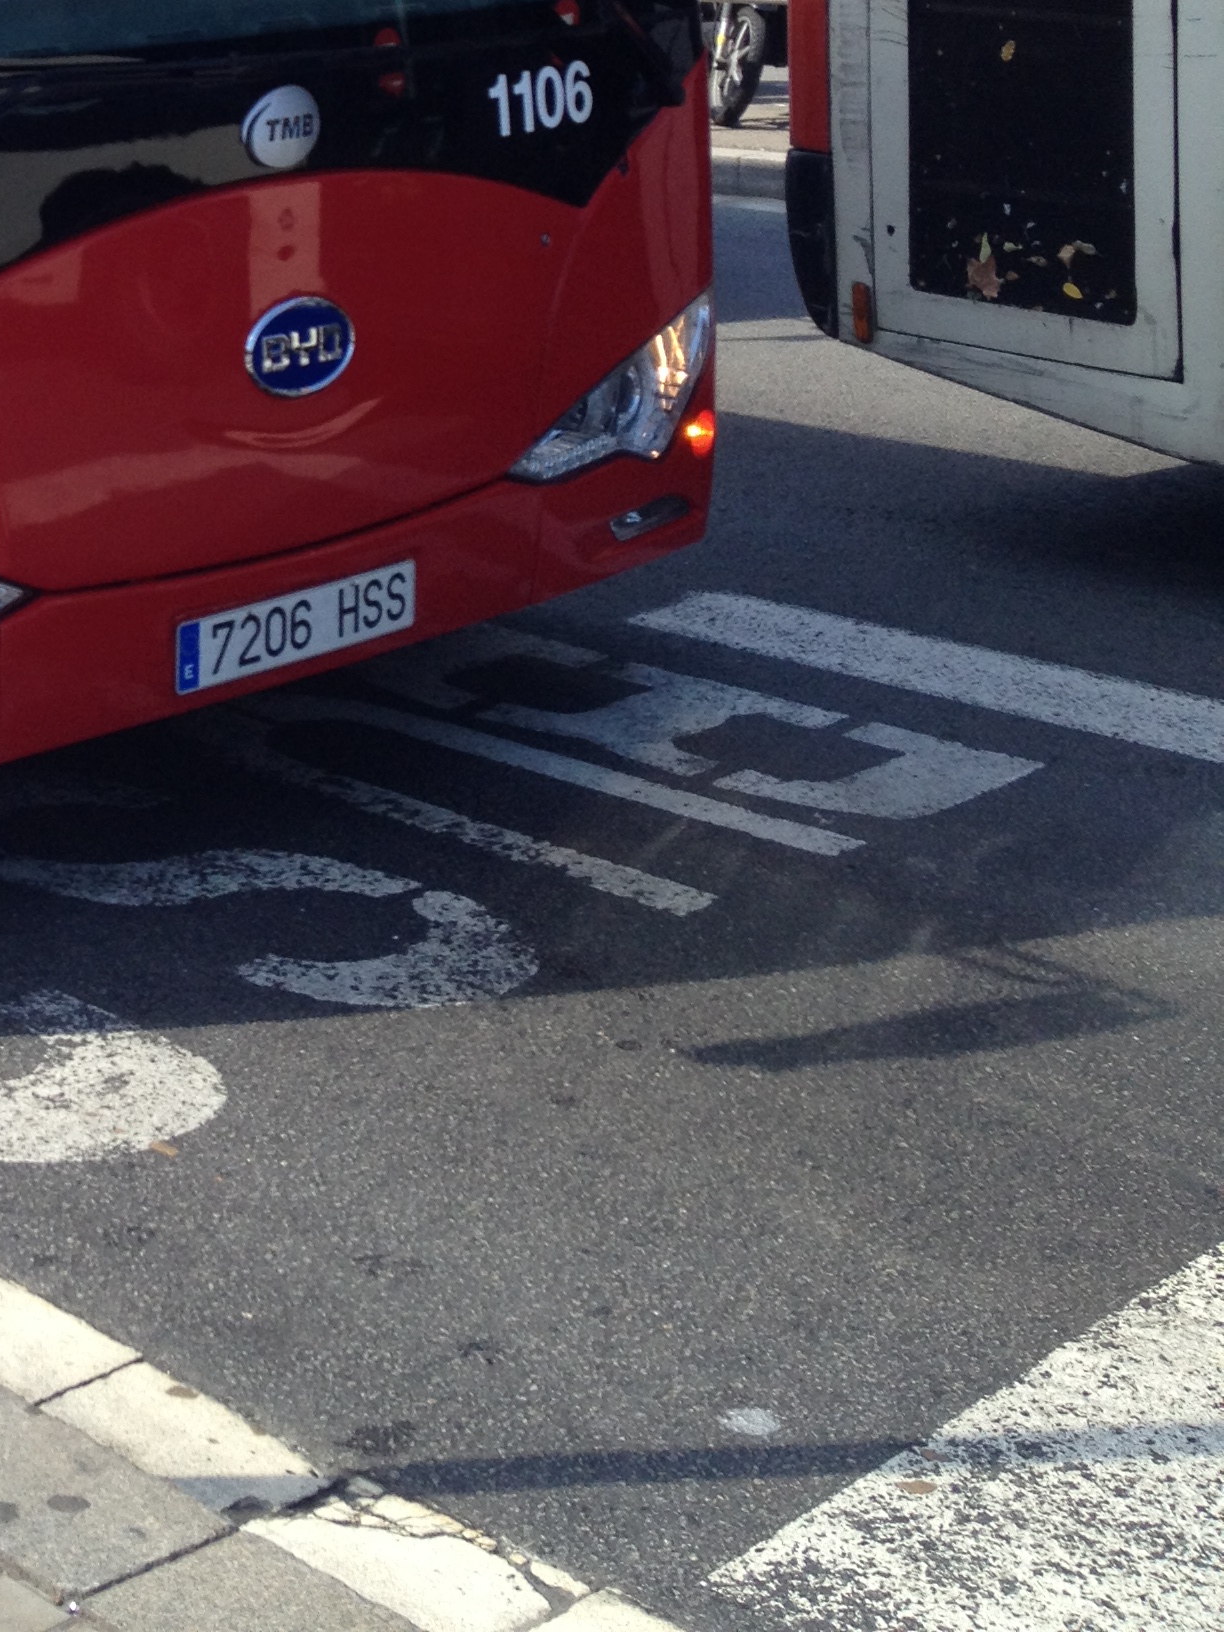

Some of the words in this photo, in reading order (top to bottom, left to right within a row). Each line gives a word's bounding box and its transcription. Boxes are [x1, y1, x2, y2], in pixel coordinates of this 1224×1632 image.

[266, 113, 314, 142] TMB
[488, 60, 593, 137] 1106
[262, 323, 342, 373] BYD
[184, 664, 195, 680] E
[212, 599, 312, 675] 7206
[338, 572, 406, 638] HSS
